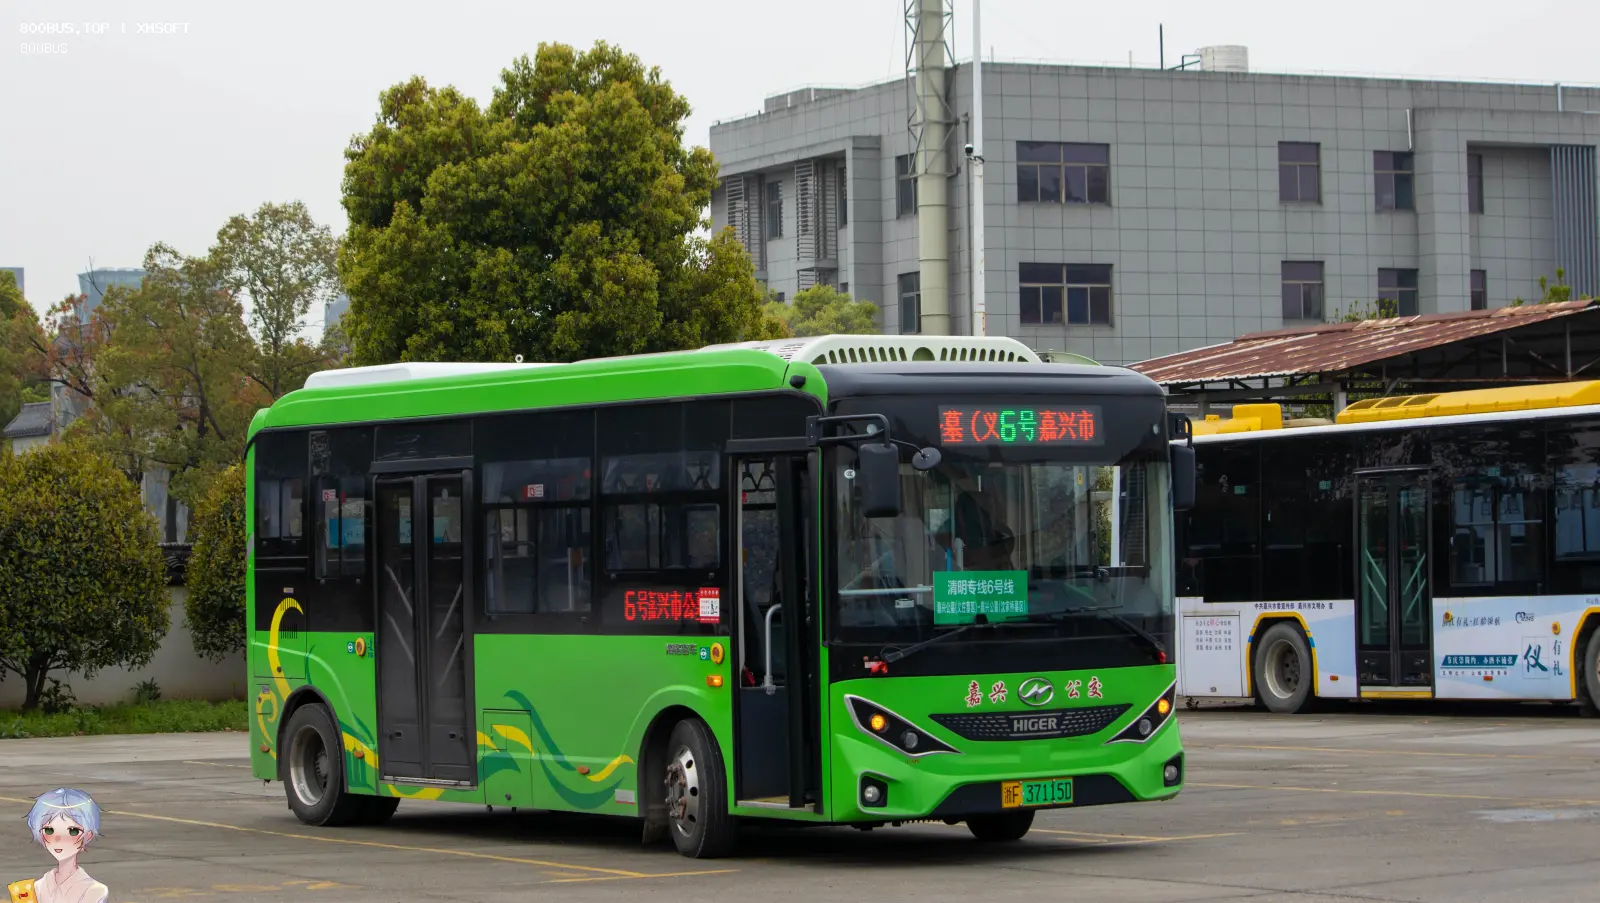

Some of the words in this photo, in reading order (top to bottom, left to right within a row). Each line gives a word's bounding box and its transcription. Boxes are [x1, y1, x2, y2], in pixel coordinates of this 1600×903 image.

[947, 579, 1014, 596] 清明专线6号线
[1523, 643, 1549, 673] 仪
[964, 679, 1009, 708] 嘉兴
[1065, 676, 1103, 699] 公交
[1012, 717, 1058, 732] HIGER
[1003, 784, 1020, 805] 浙F
[1025, 781, 1072, 803] 37115D
